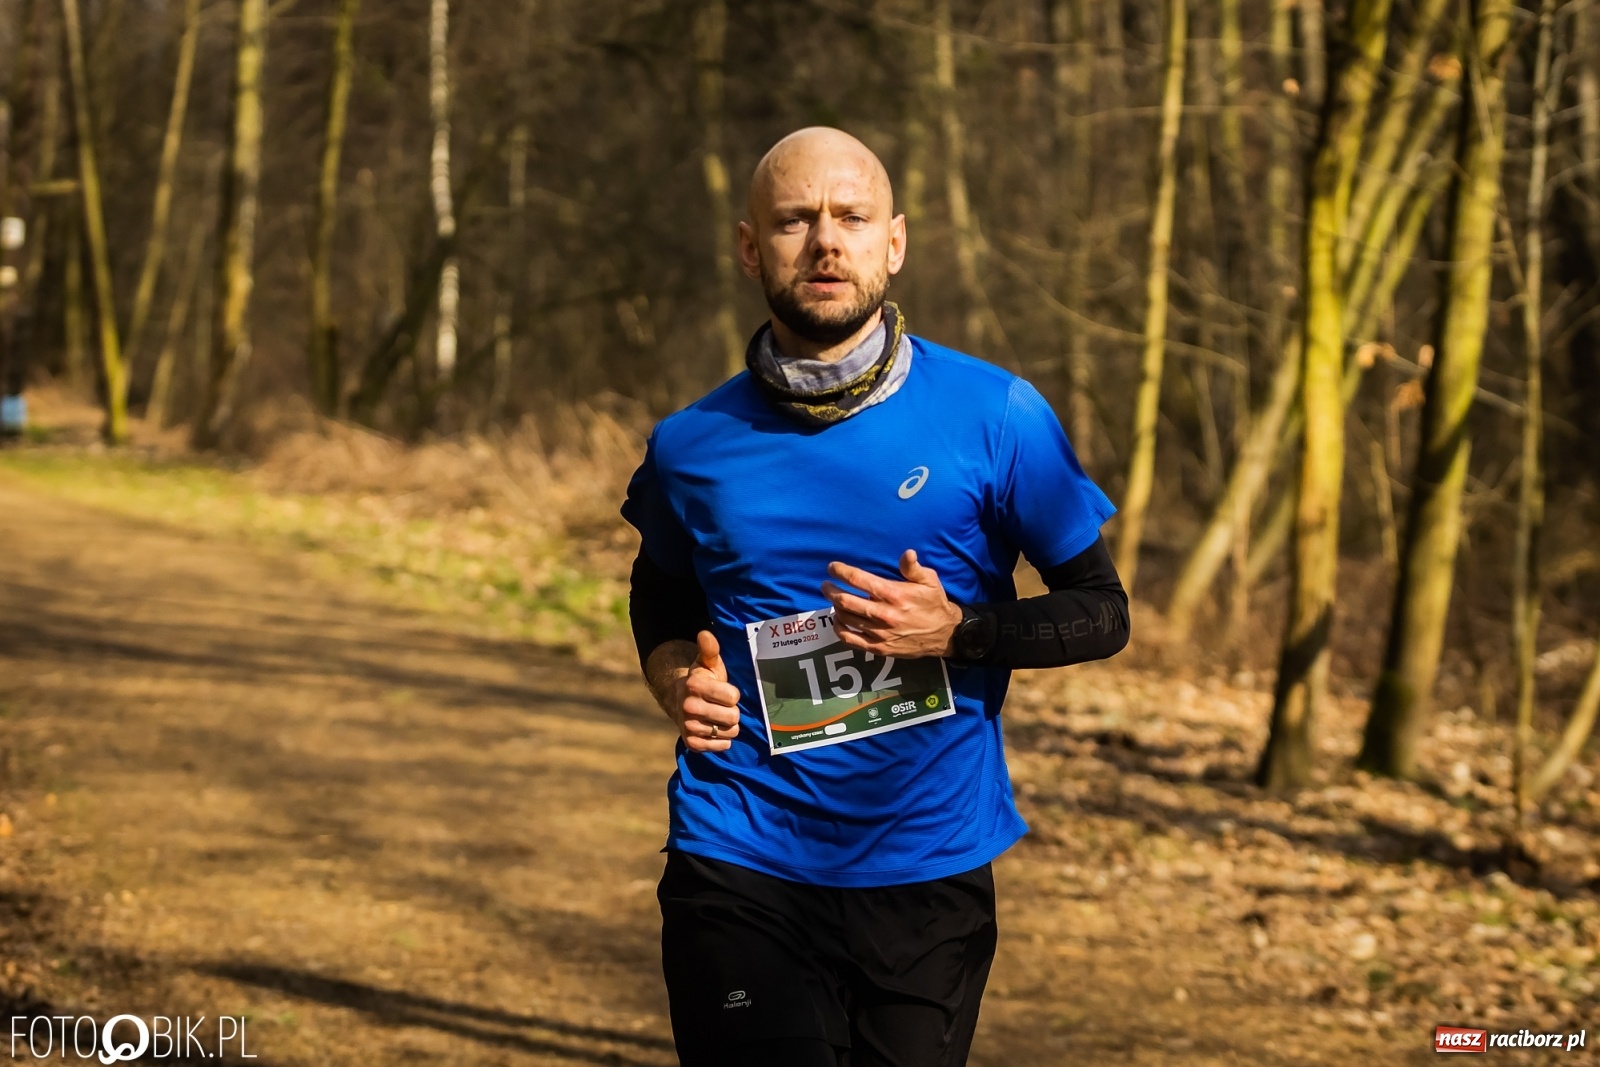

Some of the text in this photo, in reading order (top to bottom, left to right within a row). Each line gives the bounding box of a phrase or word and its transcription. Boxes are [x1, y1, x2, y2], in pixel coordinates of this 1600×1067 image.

[769, 625, 780, 638] X
[783, 618, 816, 635] BIEG
[780, 638, 802, 647] lutego
[803, 634, 819, 642] 2022
[798, 650, 902, 706] 152
[723, 998, 751, 1009] Kalenji
